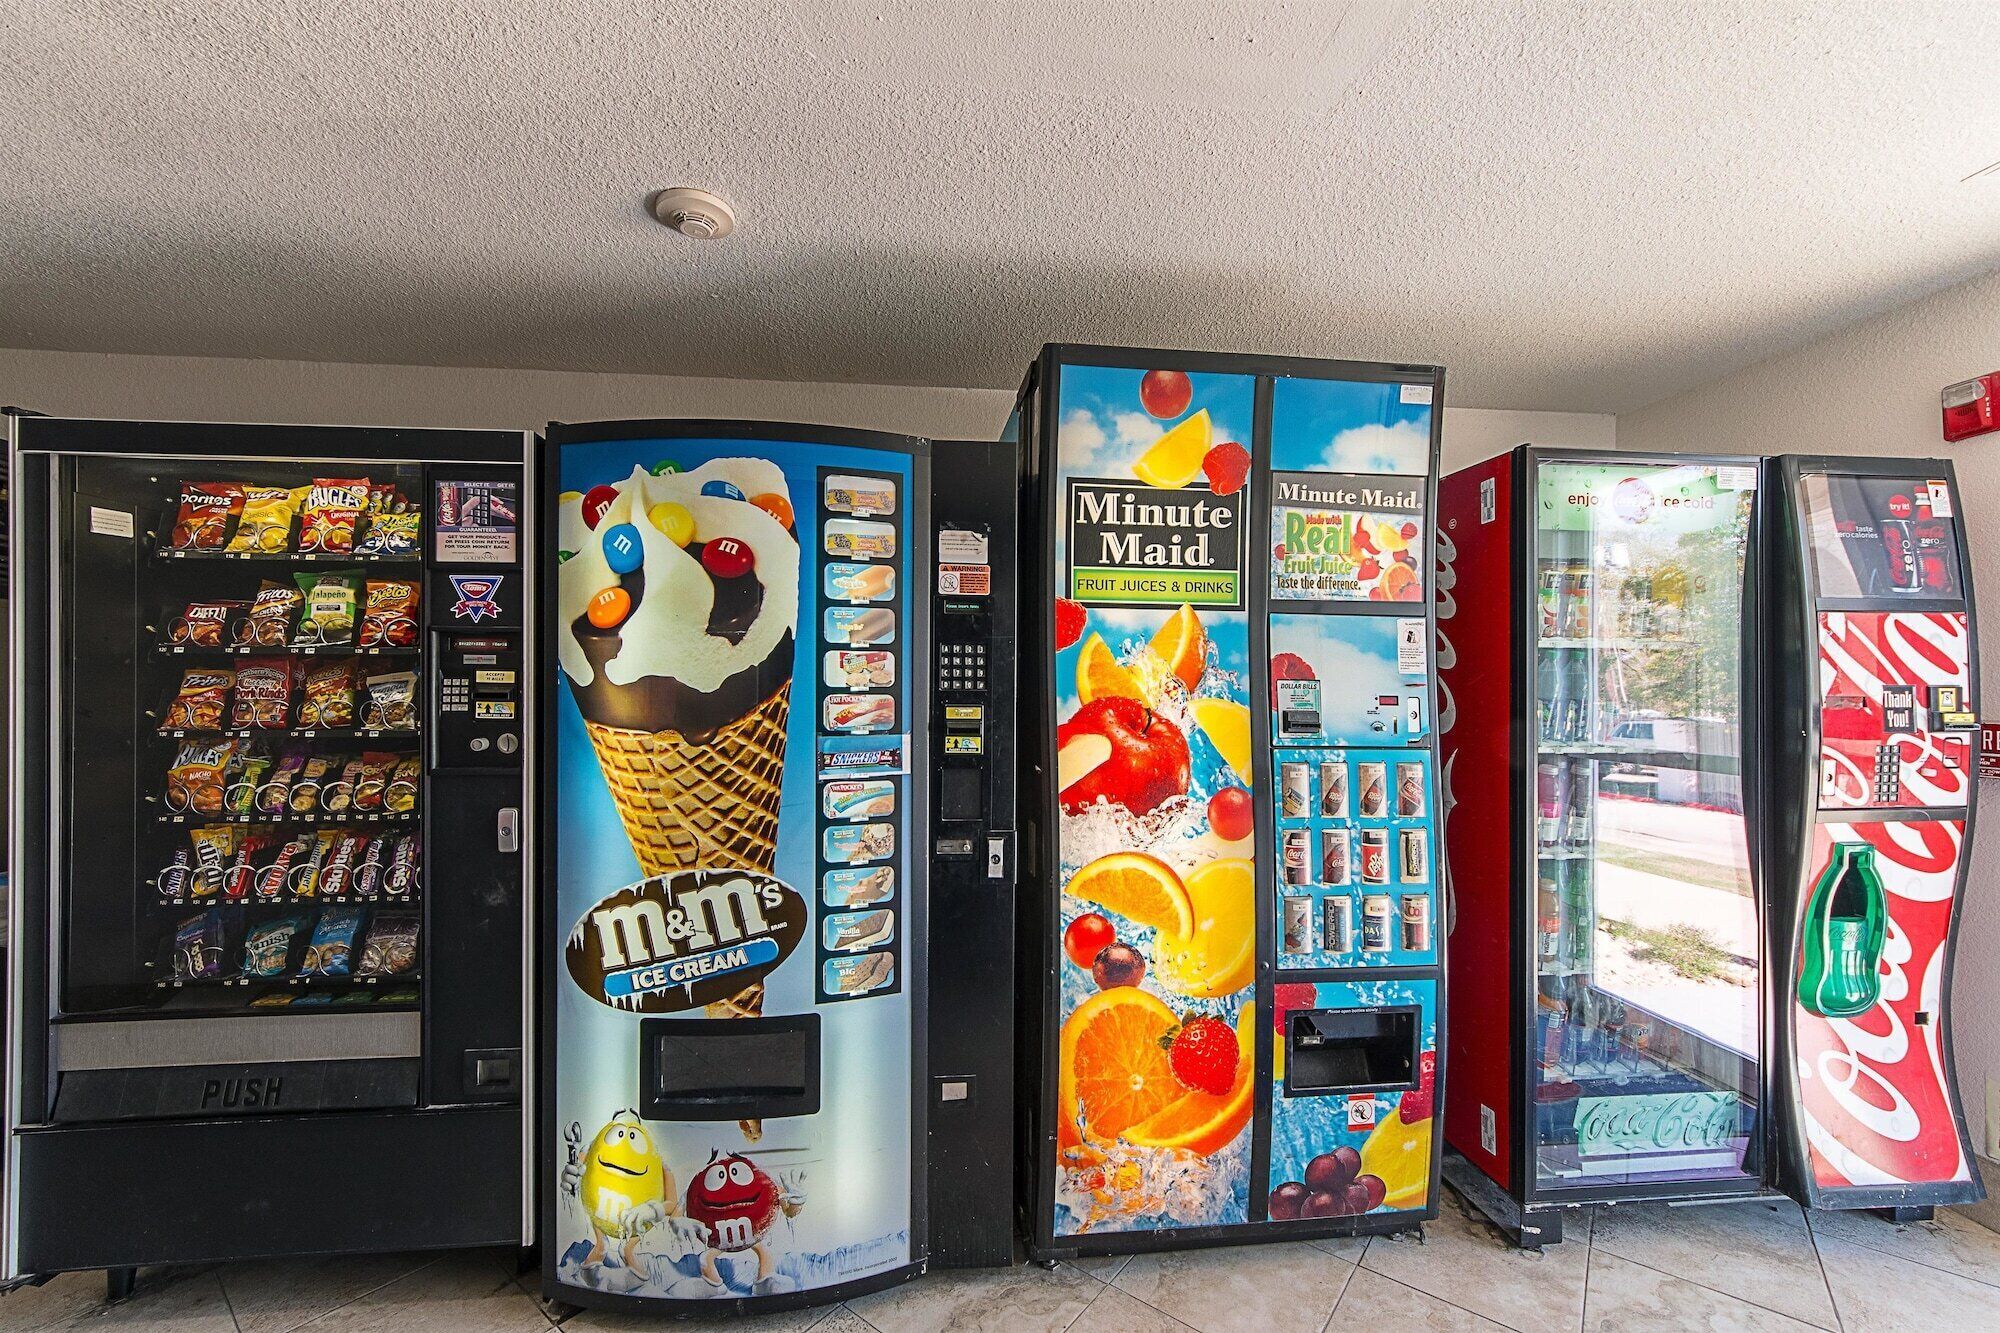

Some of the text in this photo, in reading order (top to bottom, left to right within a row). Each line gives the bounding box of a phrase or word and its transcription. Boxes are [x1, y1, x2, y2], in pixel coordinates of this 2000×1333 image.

[308, 485, 362, 510] BUGLES
[1278, 483, 1357, 504] Minute
[1660, 496, 1680, 507] ice
[1076, 492, 1233, 528] Minute
[1890, 503, 1901, 511] try
[1306, 515, 1342, 524] Made with
[1286, 511, 1352, 555] Real
[614, 534, 632, 555] m
[718, 540, 740, 556] m
[1284, 555, 1351, 574] Fruit Juice
[1902, 540, 1914, 572] zero
[1078, 579, 1233, 594] FRUIT JUICES & DRINKS
[1277, 576, 1298, 588] Taste
[1300, 576, 1314, 589] the
[598, 590, 616, 606] m
[235, 687, 287, 700] Pork Rinds
[1883, 691, 1912, 708] Thank
[1887, 711, 1909, 728] You!
[173, 747, 222, 771] BUGLES
[833, 752, 879, 765] SNICKERS
[189, 770, 212, 780] NACHO
[770, 921, 788, 931] BRAND
[631, 948, 749, 990] ICE CREAM
[839, 968, 855, 976] BIG
[201, 1077, 282, 1108] PUSH
[1579, 1094, 1738, 1149] Coca-Cola
[715, 1216, 752, 1248] m
